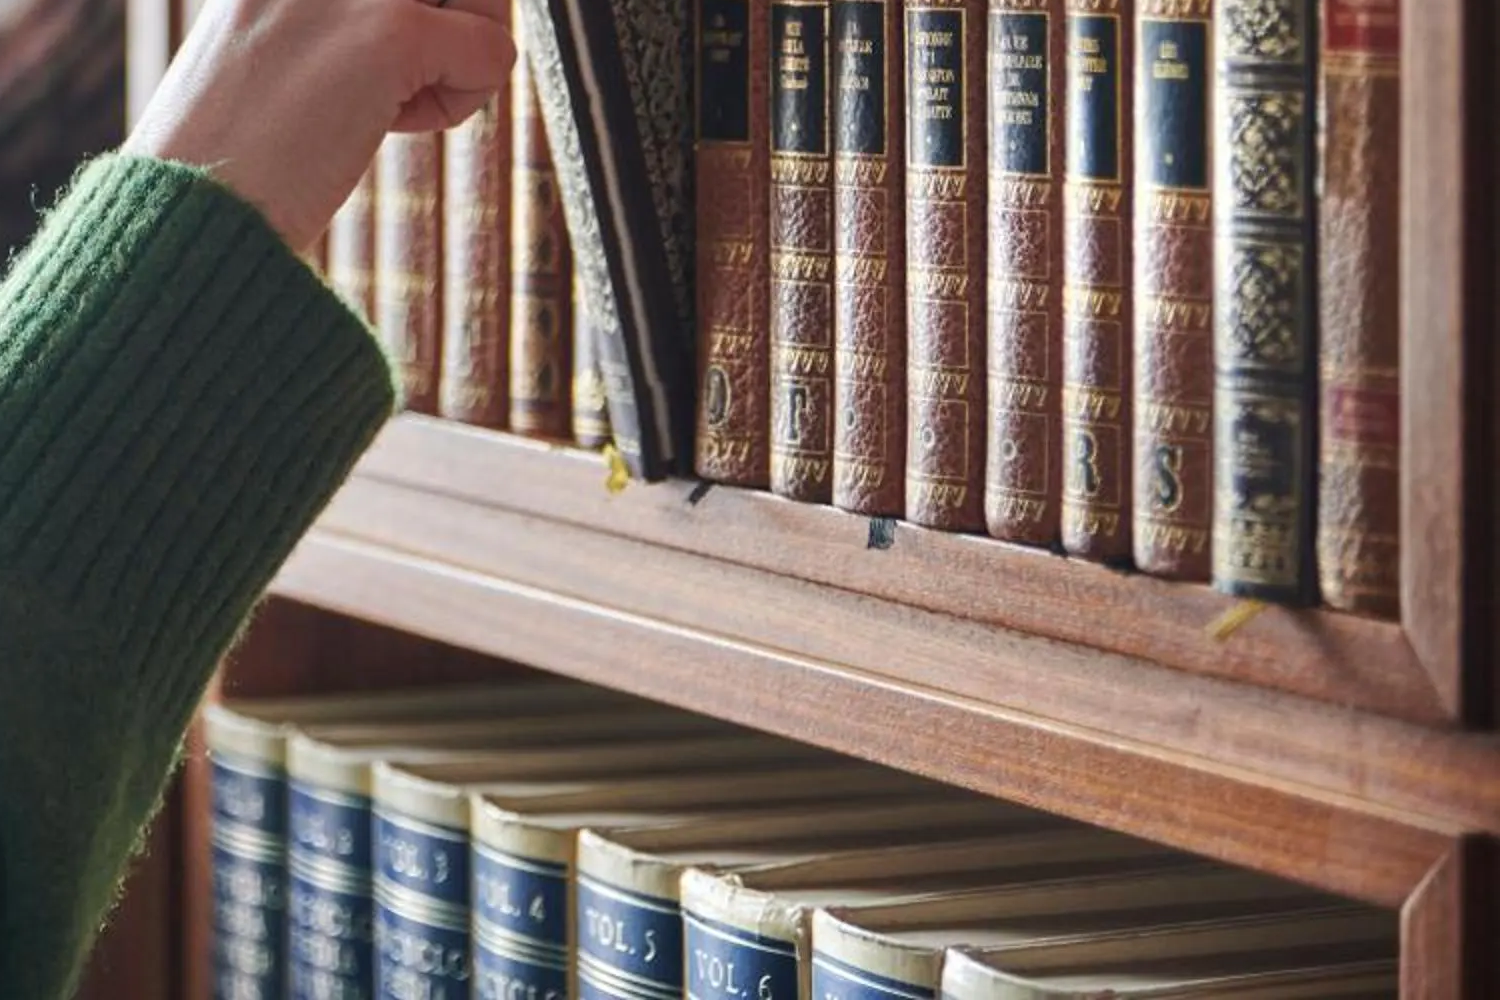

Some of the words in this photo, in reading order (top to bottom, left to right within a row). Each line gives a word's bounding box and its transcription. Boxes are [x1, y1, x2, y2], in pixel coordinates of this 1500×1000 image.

[1155, 443, 1183, 513] S
[529, 895, 545, 921] 4
[585, 909, 636, 955] VOL.
[644, 929, 656, 962] 5
[695, 949, 747, 998] VOL.
[758, 975, 772, 1000] 6
